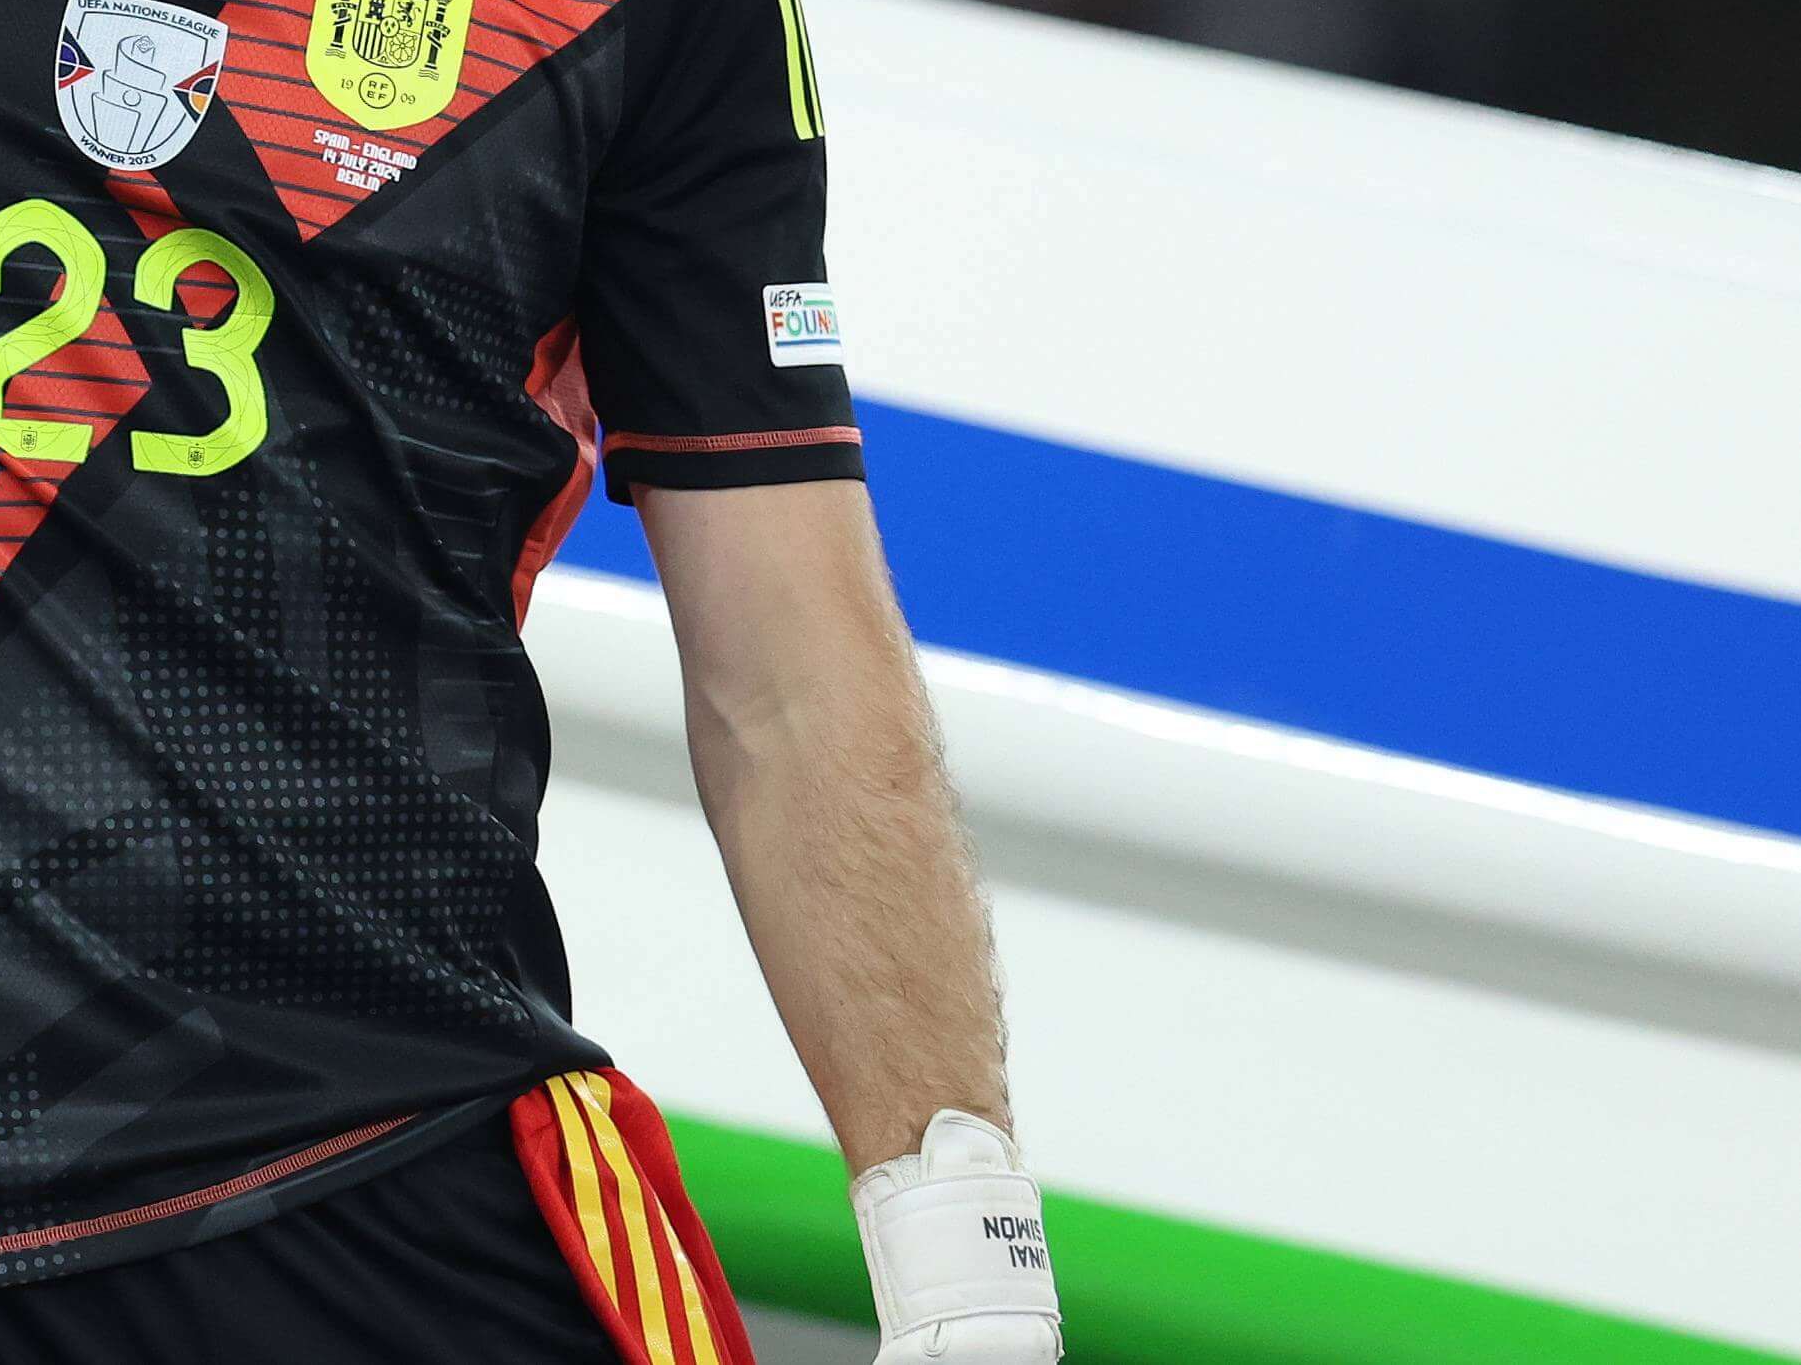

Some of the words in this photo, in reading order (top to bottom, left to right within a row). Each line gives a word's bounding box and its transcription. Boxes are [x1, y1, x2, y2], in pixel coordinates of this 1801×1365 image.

[78, 0, 110, 10] UEFA
[113, 2, 169, 20] NATIONS
[172, 14, 220, 39] LEAGUE
[81, 135, 126, 164] WINNER
[128, 154, 157, 165] 2023
[313, 130, 350, 150] SPAIN
[363, 142, 417, 170] ENGLAND
[323, 148, 337, 164] 14
[338, 152, 367, 172] JULY
[368, 161, 401, 182] 2024
[336, 167, 381, 192] BERLIN
[769, 290, 802, 307] UEFA
